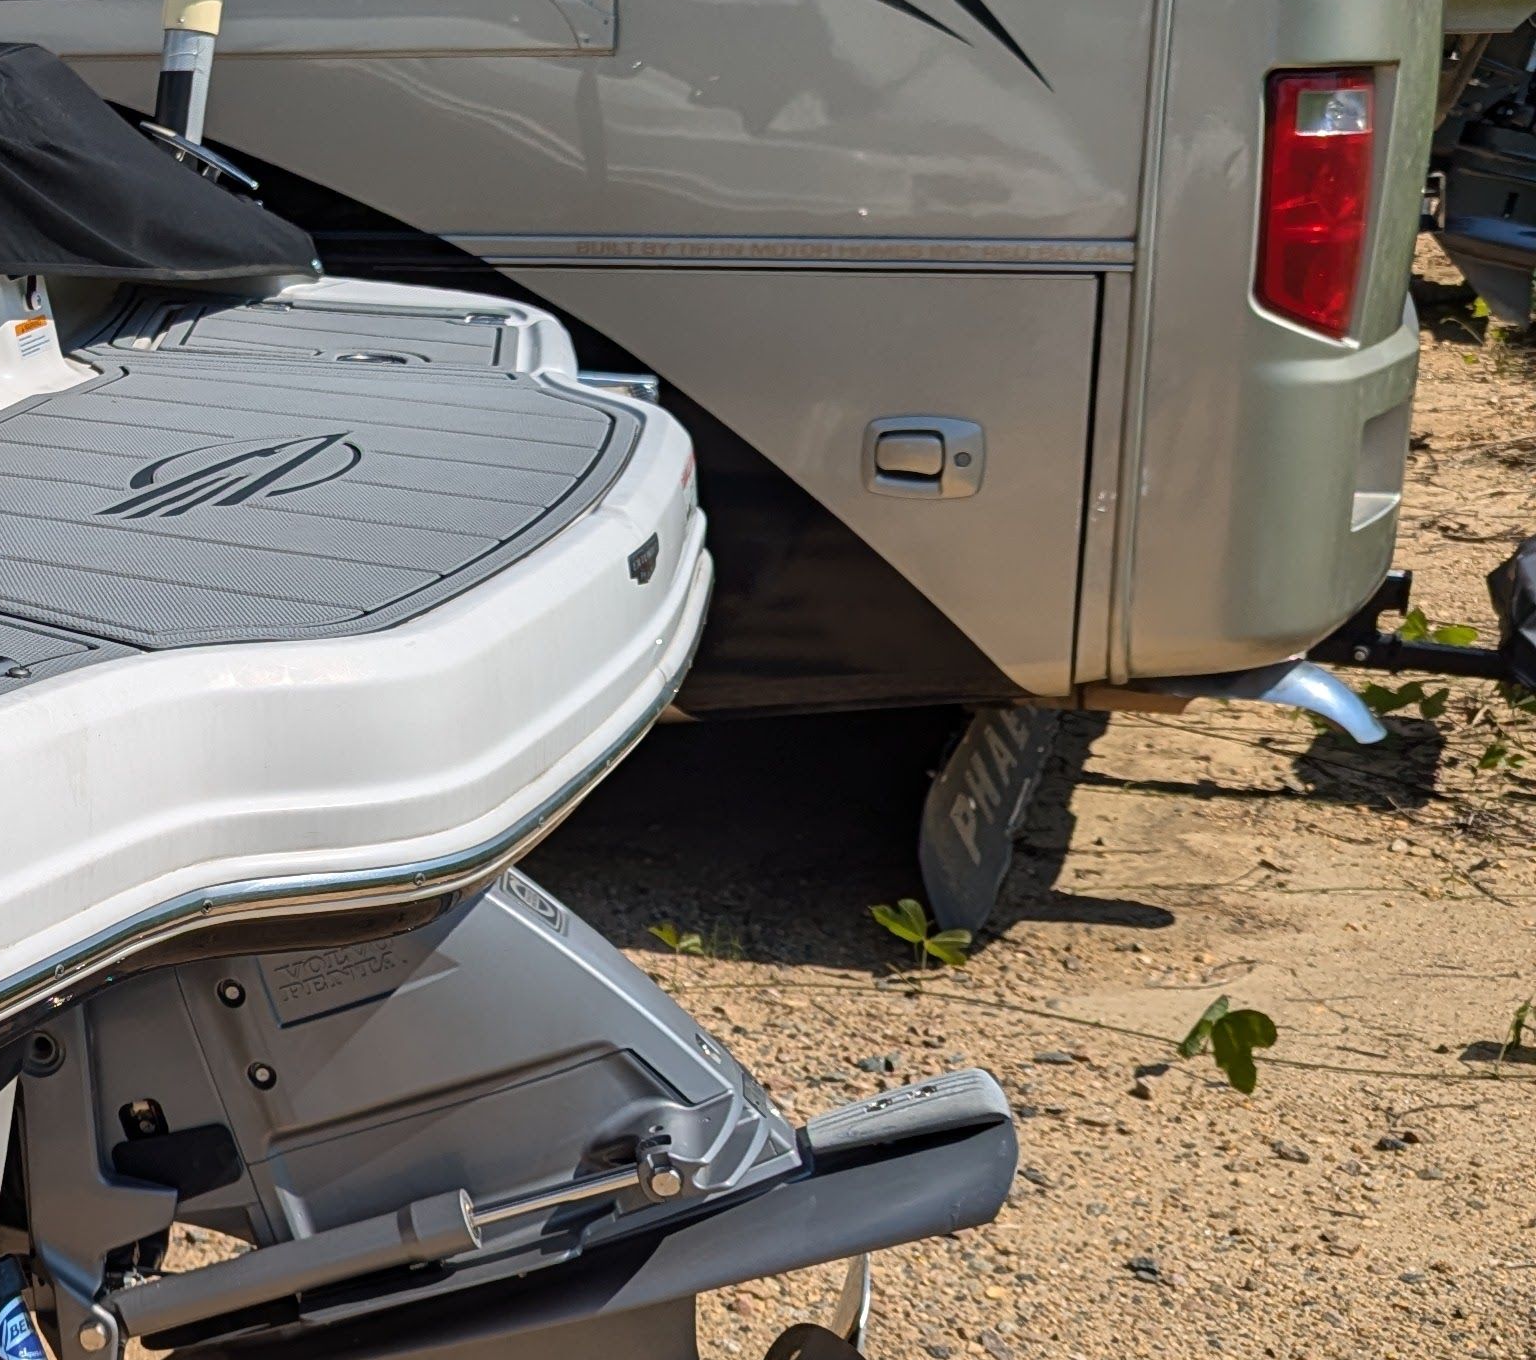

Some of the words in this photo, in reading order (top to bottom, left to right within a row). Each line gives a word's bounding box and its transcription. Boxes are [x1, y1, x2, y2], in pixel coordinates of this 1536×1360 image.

[575, 242, 632, 256] BUILT
[640, 242, 670, 256] BY
[278, 951, 395, 1003] PENTA
